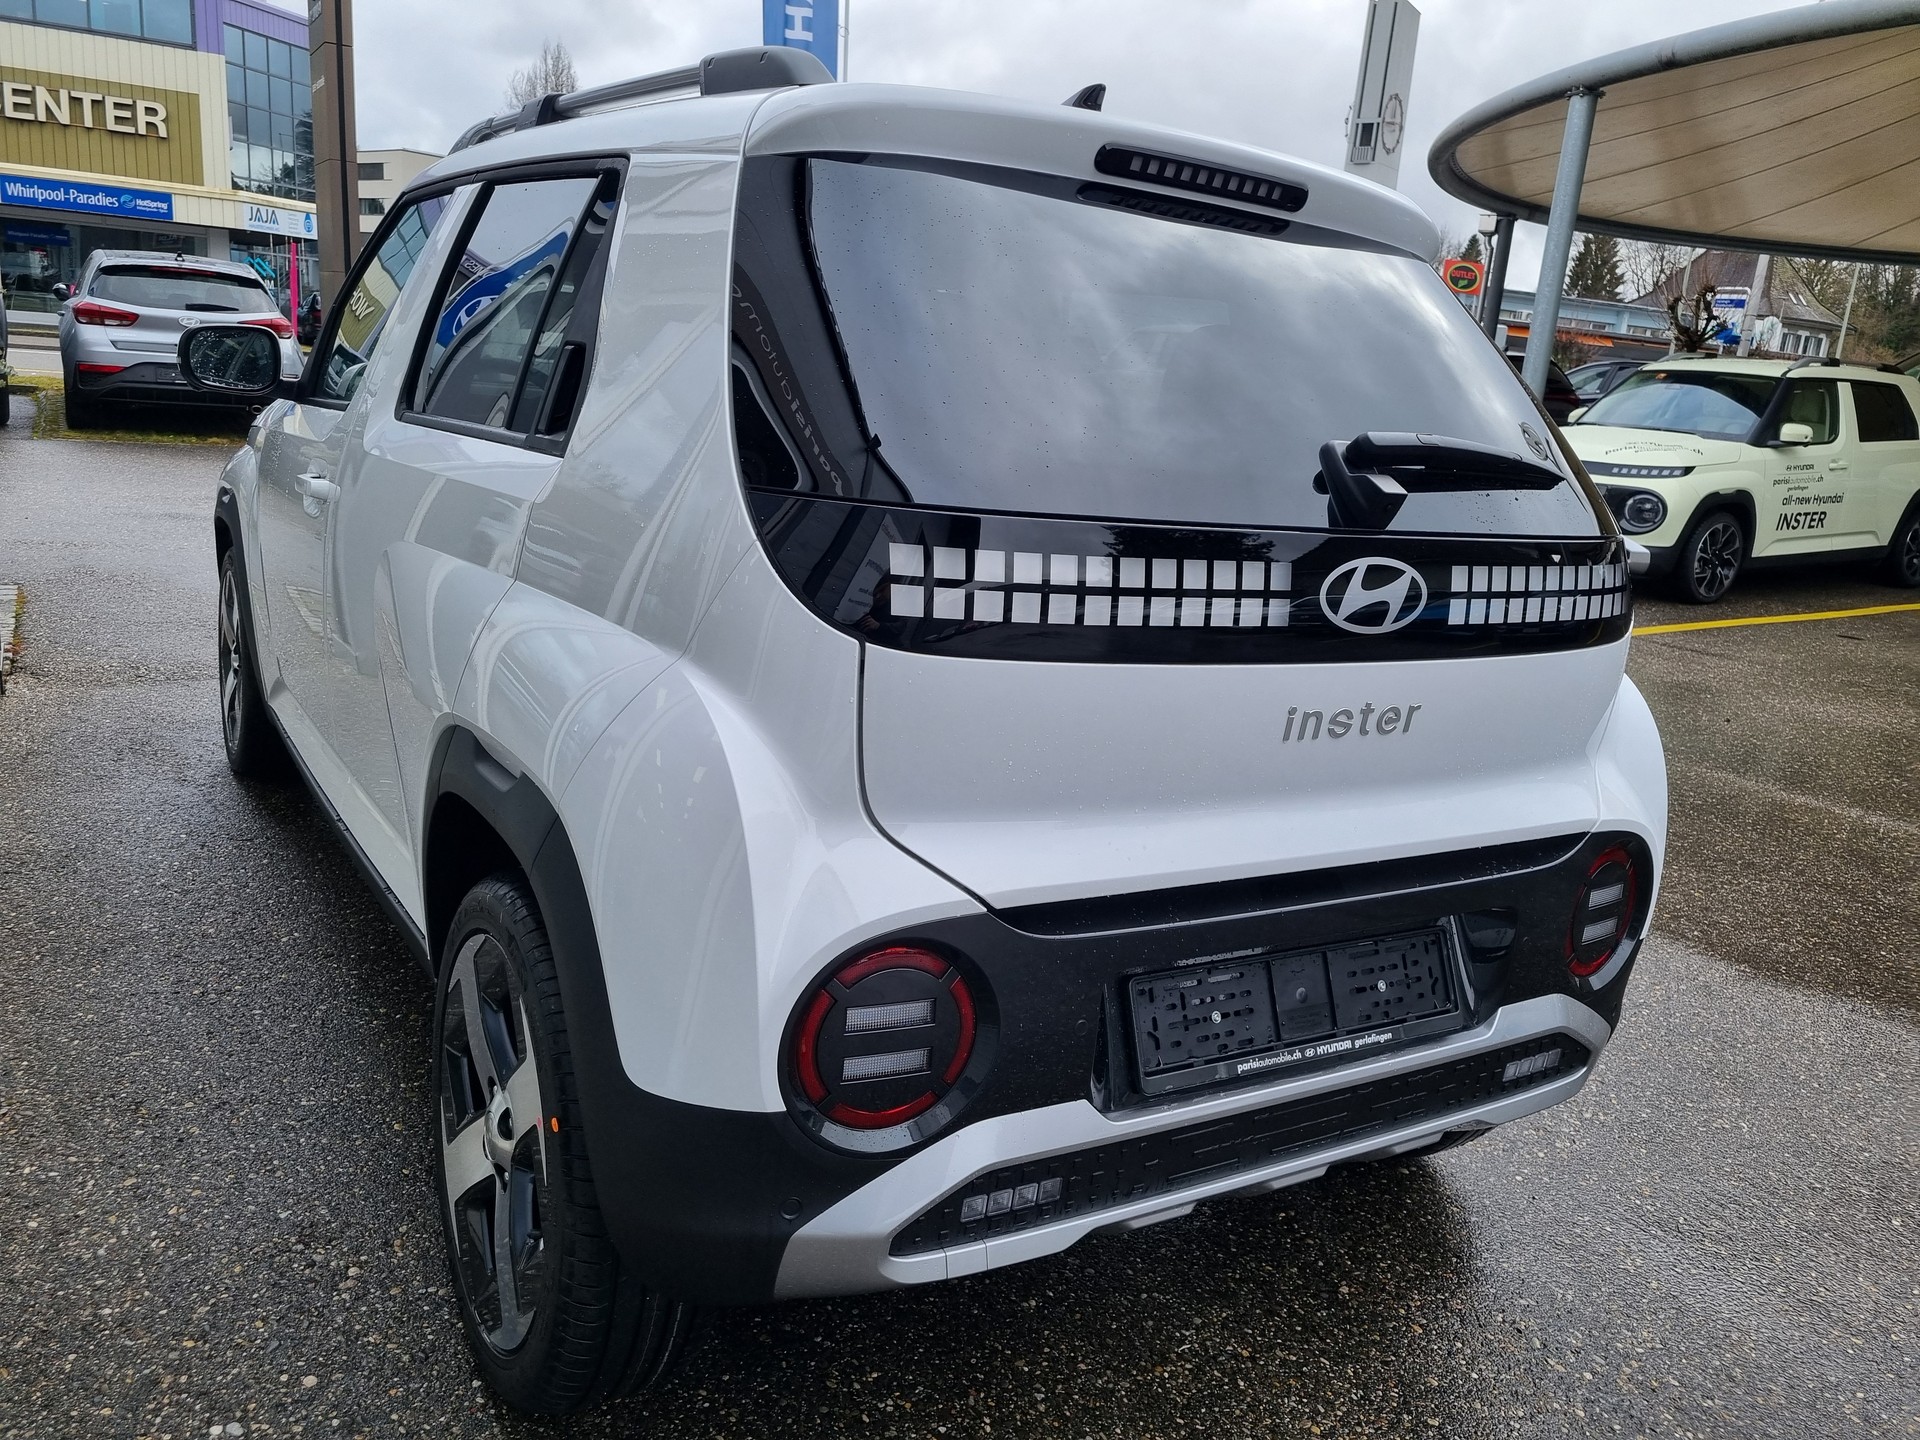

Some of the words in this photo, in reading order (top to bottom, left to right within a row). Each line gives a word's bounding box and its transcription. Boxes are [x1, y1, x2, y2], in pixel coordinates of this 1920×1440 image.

[0, 81, 168, 139] ENTER
[5, 182, 119, 208] Whirlpool-Paradies
[136, 198, 168, 210] HotSpring
[249, 206, 279, 226] JAJA
[1451, 270, 1476, 280] OUTLET
[1793, 463, 1815, 471] HYUNDAI
[1782, 495, 1813, 506] all-new
[1812, 492, 1845, 507] Hyundai
[1775, 511, 1828, 531] INSTER
[1282, 702, 1423, 744] inster
[1237, 1049, 1302, 1074] parisiautomobile.ch
[1316, 1039, 1353, 1056] HYUNDAI
[1354, 1032, 1393, 1049] gerlafingen
